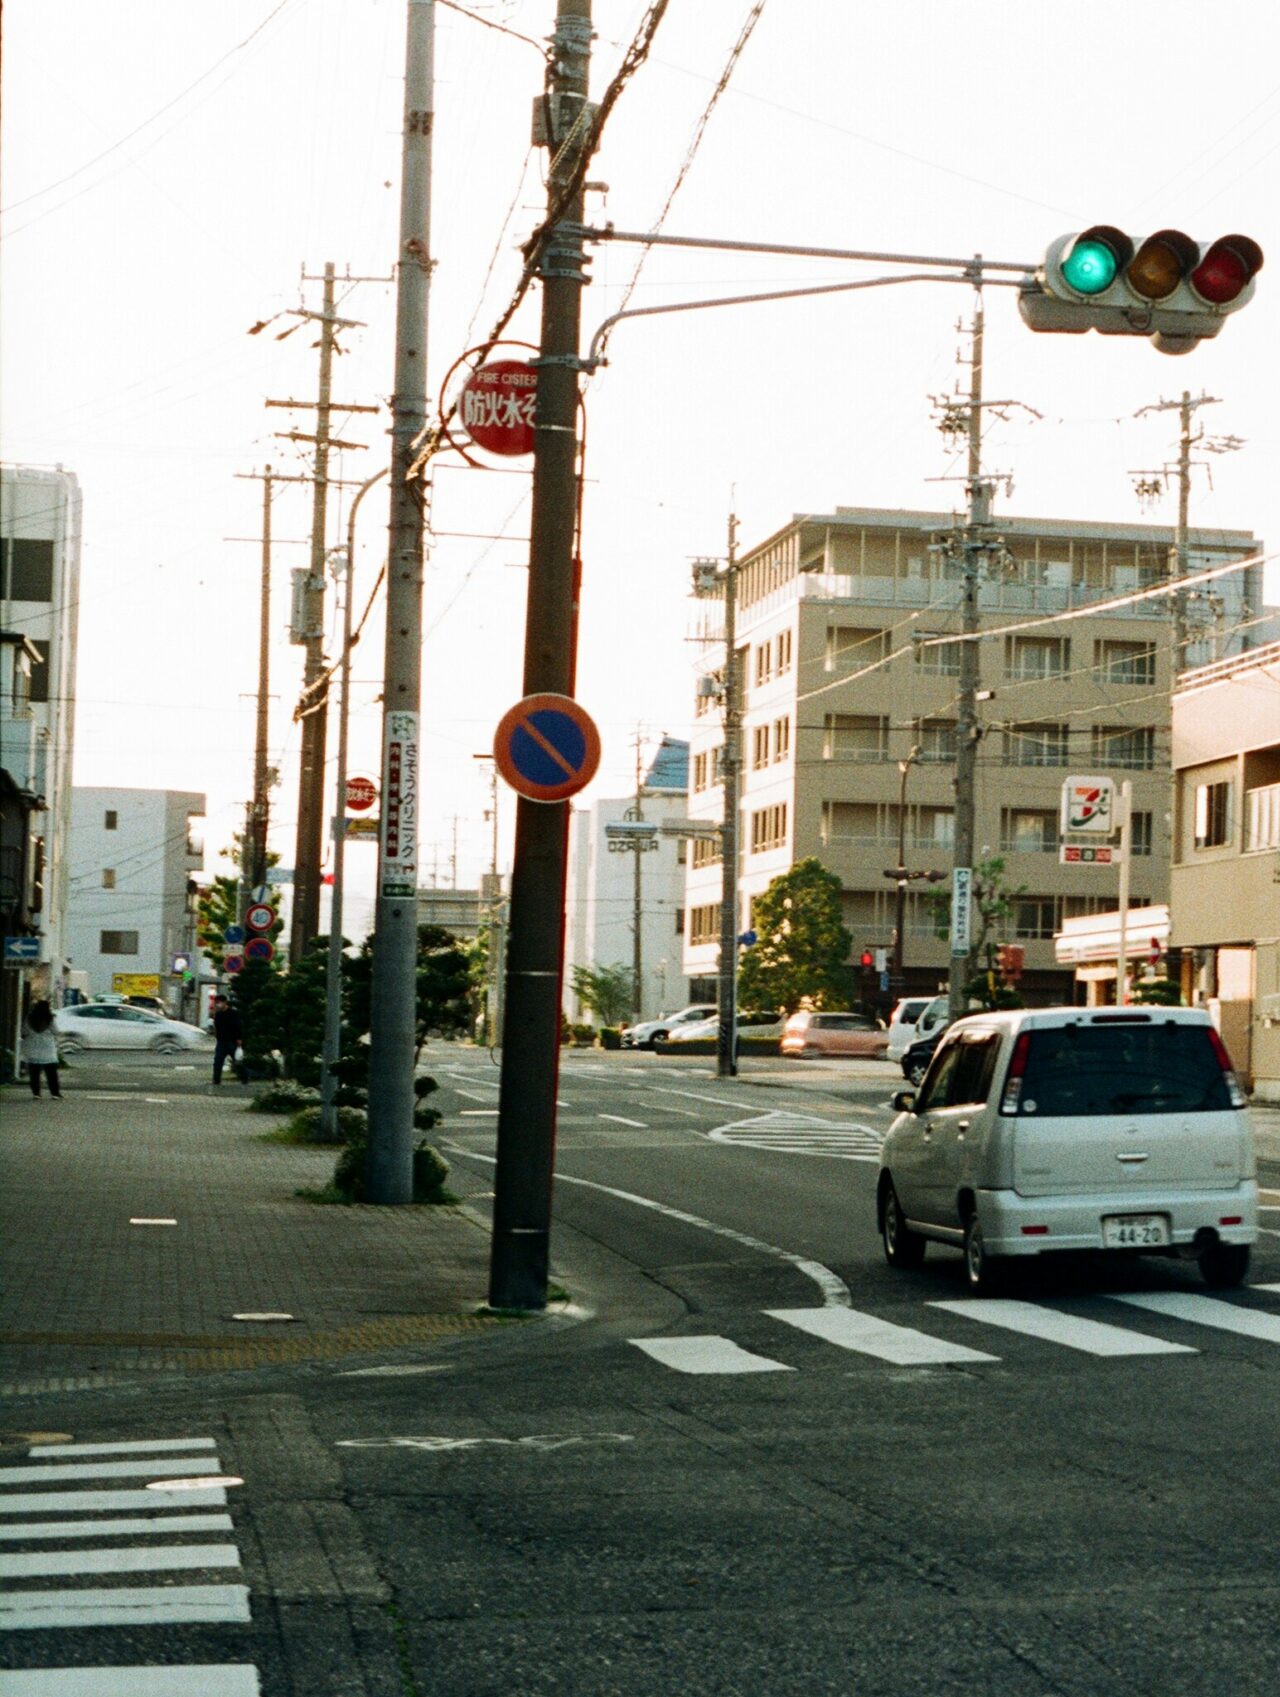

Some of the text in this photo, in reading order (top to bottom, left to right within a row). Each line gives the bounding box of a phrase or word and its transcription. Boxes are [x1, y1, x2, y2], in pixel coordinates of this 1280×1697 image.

[477, 372, 538, 385] FIRE CISTER
[464, 390, 537, 428] 防火水そ
[401, 744, 417, 858] さそうクリニック
